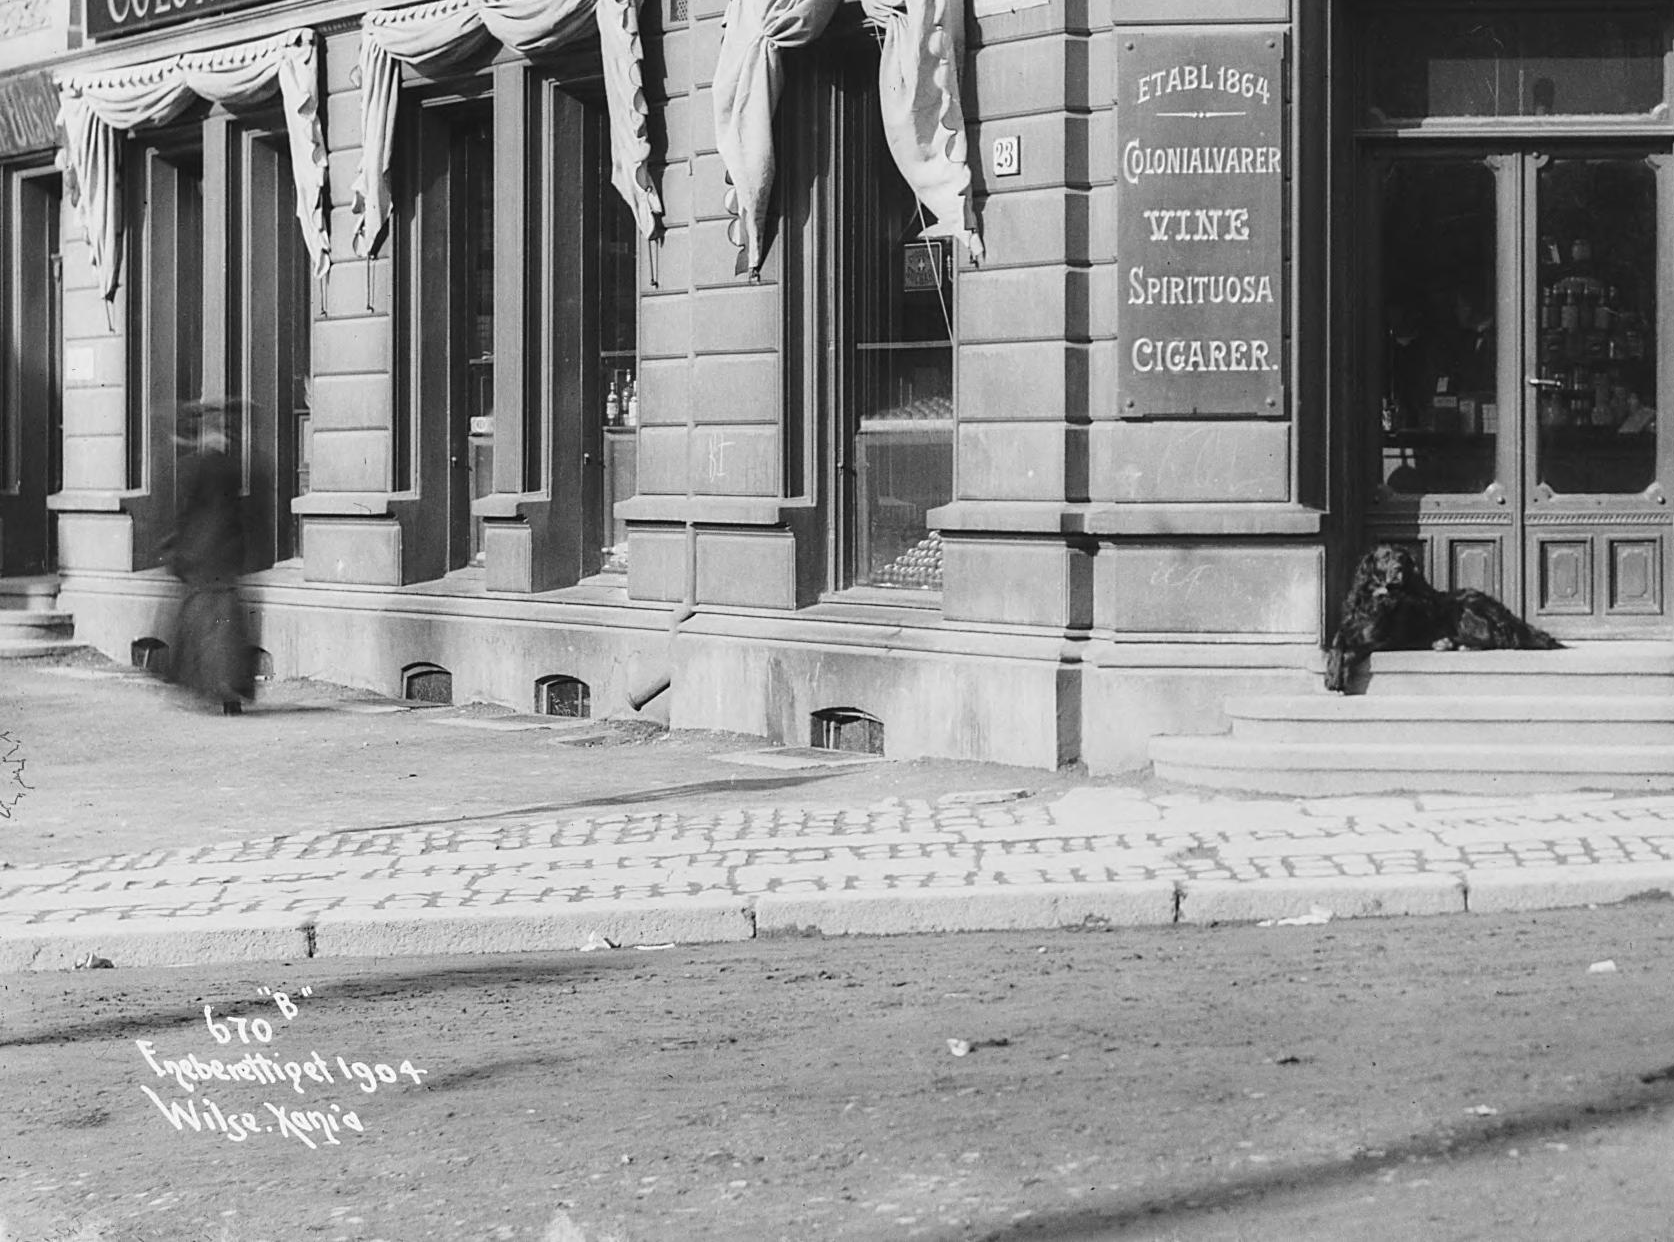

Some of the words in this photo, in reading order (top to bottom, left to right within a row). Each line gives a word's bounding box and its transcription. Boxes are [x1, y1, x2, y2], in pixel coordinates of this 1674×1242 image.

[1137, 63, 1213, 104] ETABL
[1216, 66, 1271, 105] 1864
[995, 140, 1014, 168] 23
[1123, 137, 1282, 185] COLONIALVARER
[1143, 208, 1250, 241] VINE
[1127, 265, 1274, 305] SPIRITUOSA
[1131, 337, 1279, 373] CIGARER.
